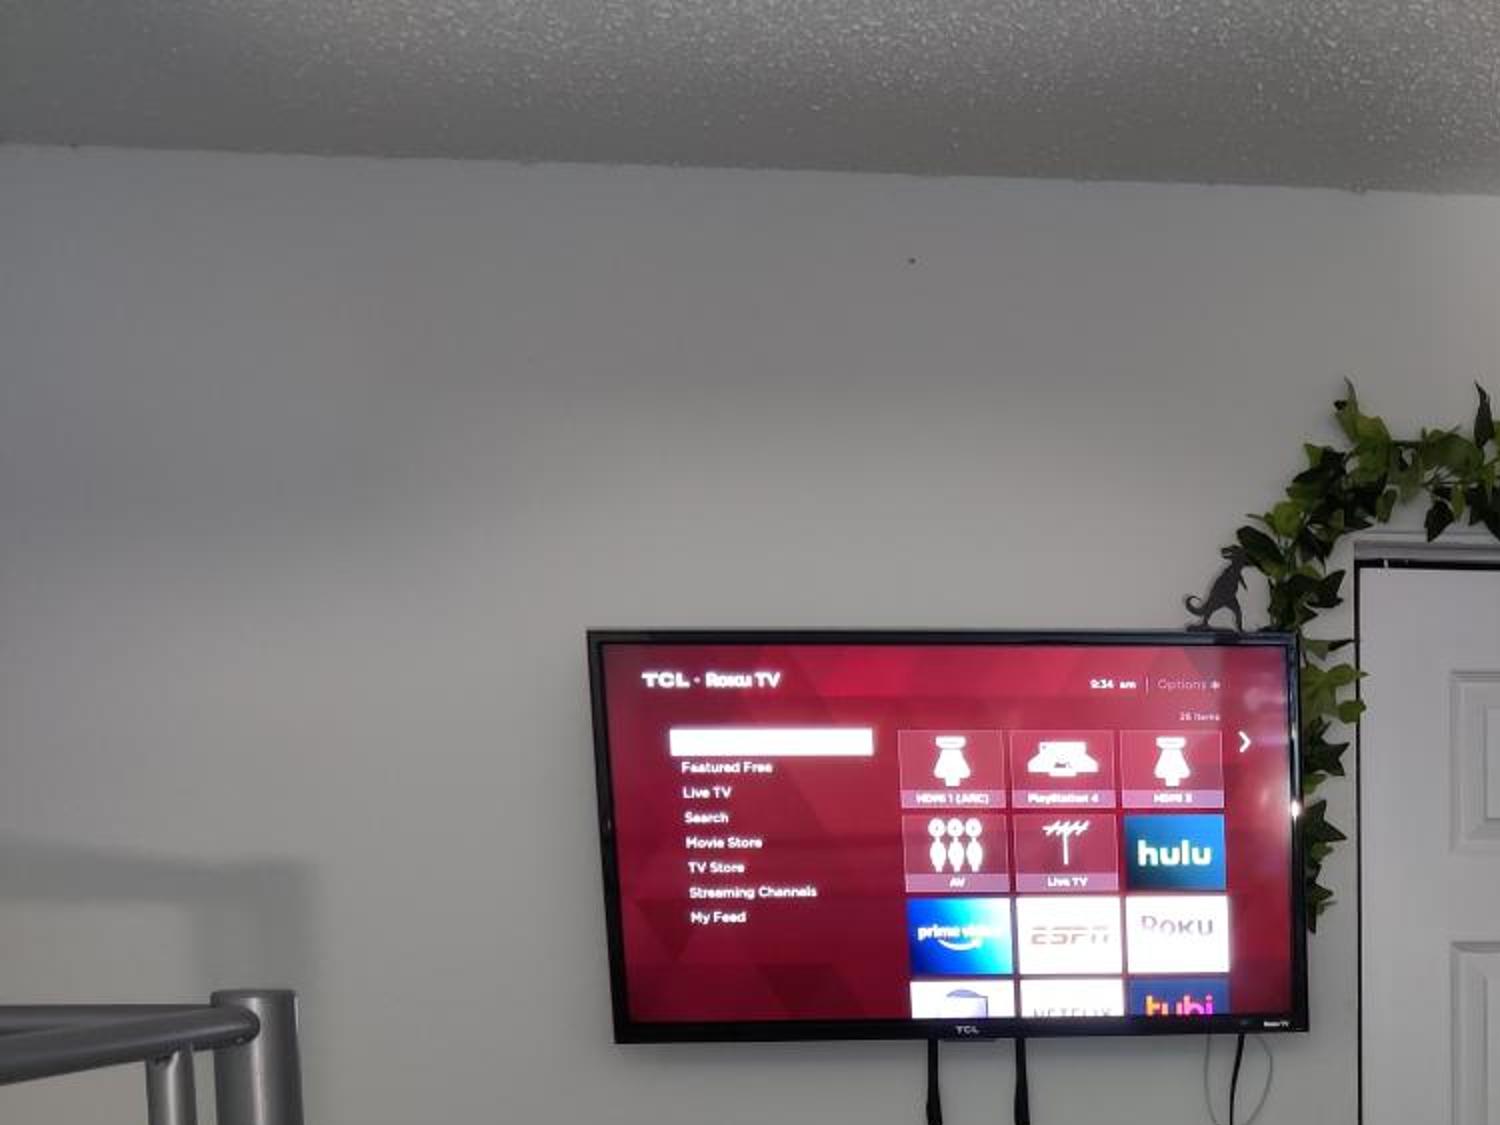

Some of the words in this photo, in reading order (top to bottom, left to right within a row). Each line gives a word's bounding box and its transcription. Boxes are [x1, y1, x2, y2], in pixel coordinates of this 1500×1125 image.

[642, 672, 690, 688] TCL
[705, 672, 752, 688] Roku
[755, 672, 780, 688] TV
[1157, 679, 1206, 691] Options
[681, 761, 740, 773] Featured
[743, 761, 773, 773] Free
[682, 786, 710, 798] Live
[713, 786, 731, 798] TV
[684, 811, 729, 824] Search
[685, 837, 724, 849] Movie
[727, 837, 763, 849] Store
[1137, 840, 1212, 867] hulu
[688, 862, 707, 873] TV
[709, 862, 745, 873] Store
[1047, 877, 1065, 887] Live
[1067, 877, 1088, 887] TV
[689, 886, 755, 901] Streaming
[758, 886, 817, 898] Channels
[691, 912, 709, 924] My
[714, 911, 747, 923] Feed
[917, 924, 960, 941] prime
[955, 1025, 979, 1035] TCL
